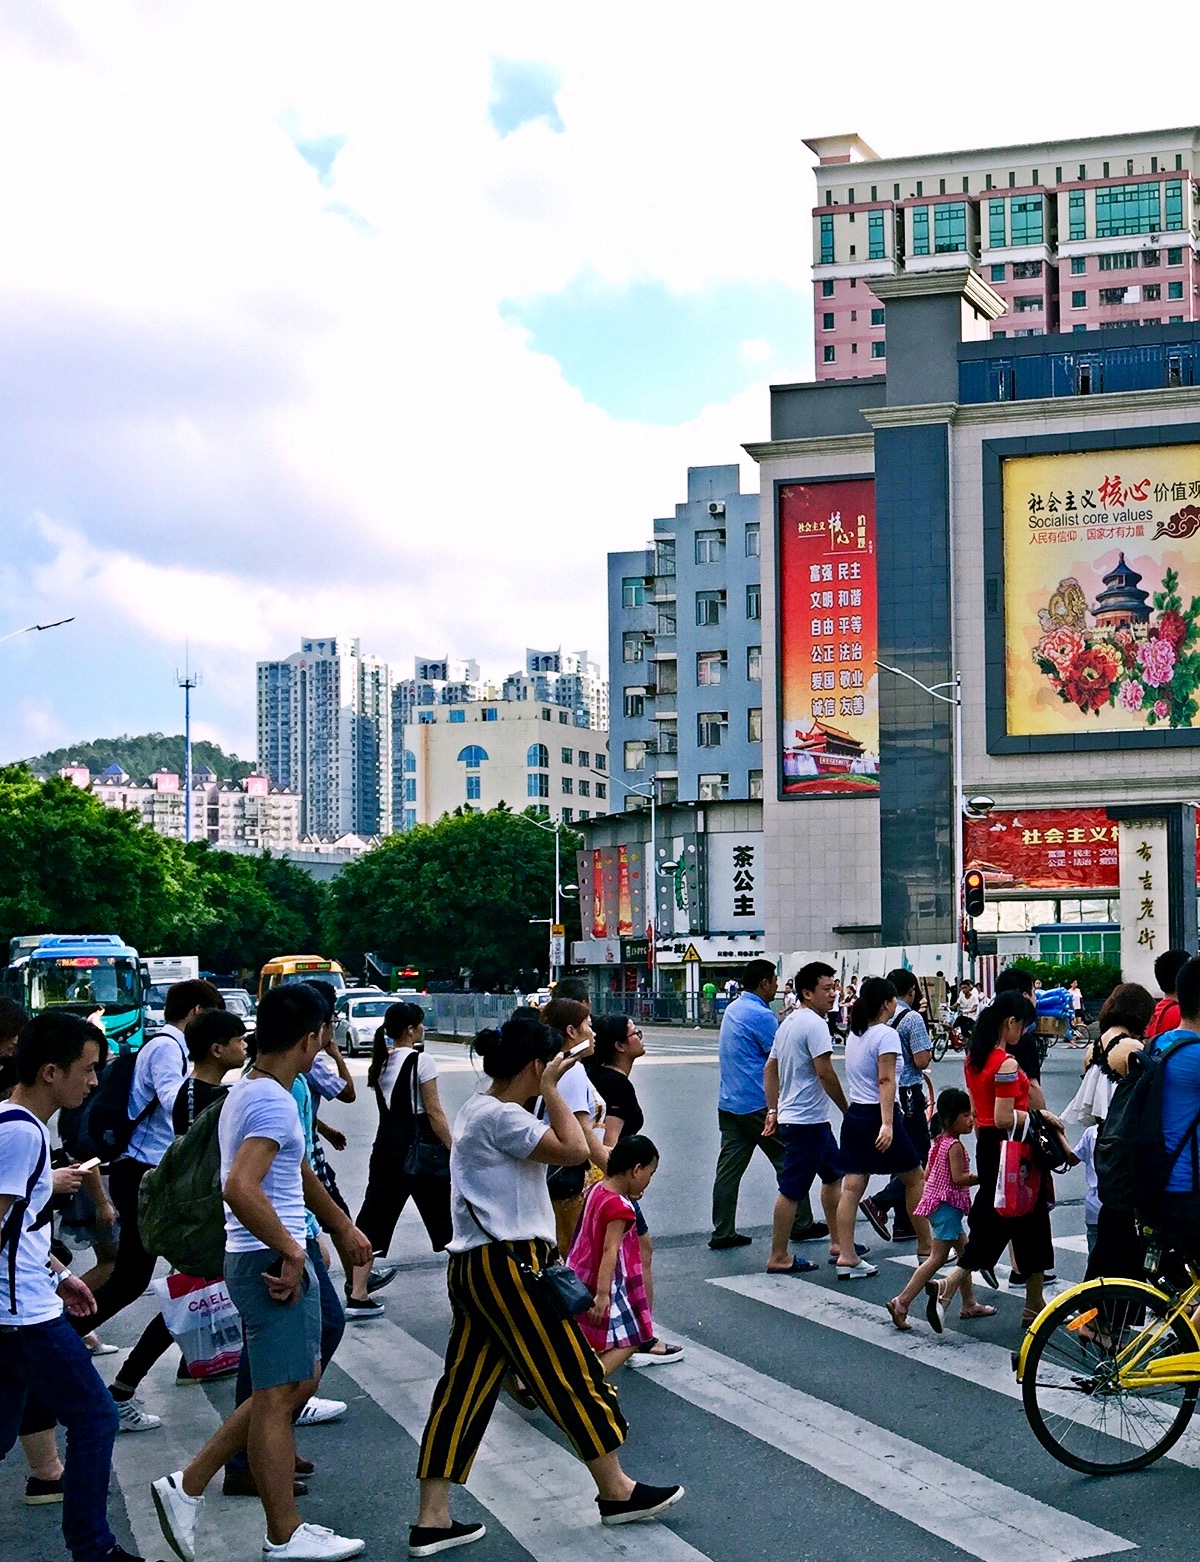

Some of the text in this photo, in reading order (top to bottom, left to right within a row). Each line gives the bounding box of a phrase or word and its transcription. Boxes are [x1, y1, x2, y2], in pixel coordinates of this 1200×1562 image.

[1028, 508, 1153, 529] Socialist core values
[809, 561, 862, 583] 富强 民主
[809, 587, 862, 609] 文明 和谐
[811, 615, 862, 636] 自由 平等
[811, 642, 862, 663] 公正 法治
[811, 669, 864, 690] 爱国 敬业
[811, 695, 864, 718] 诚信 友善
[733, 846, 755, 917] 茶公主
[1136, 841, 1156, 951] 布吉老街
